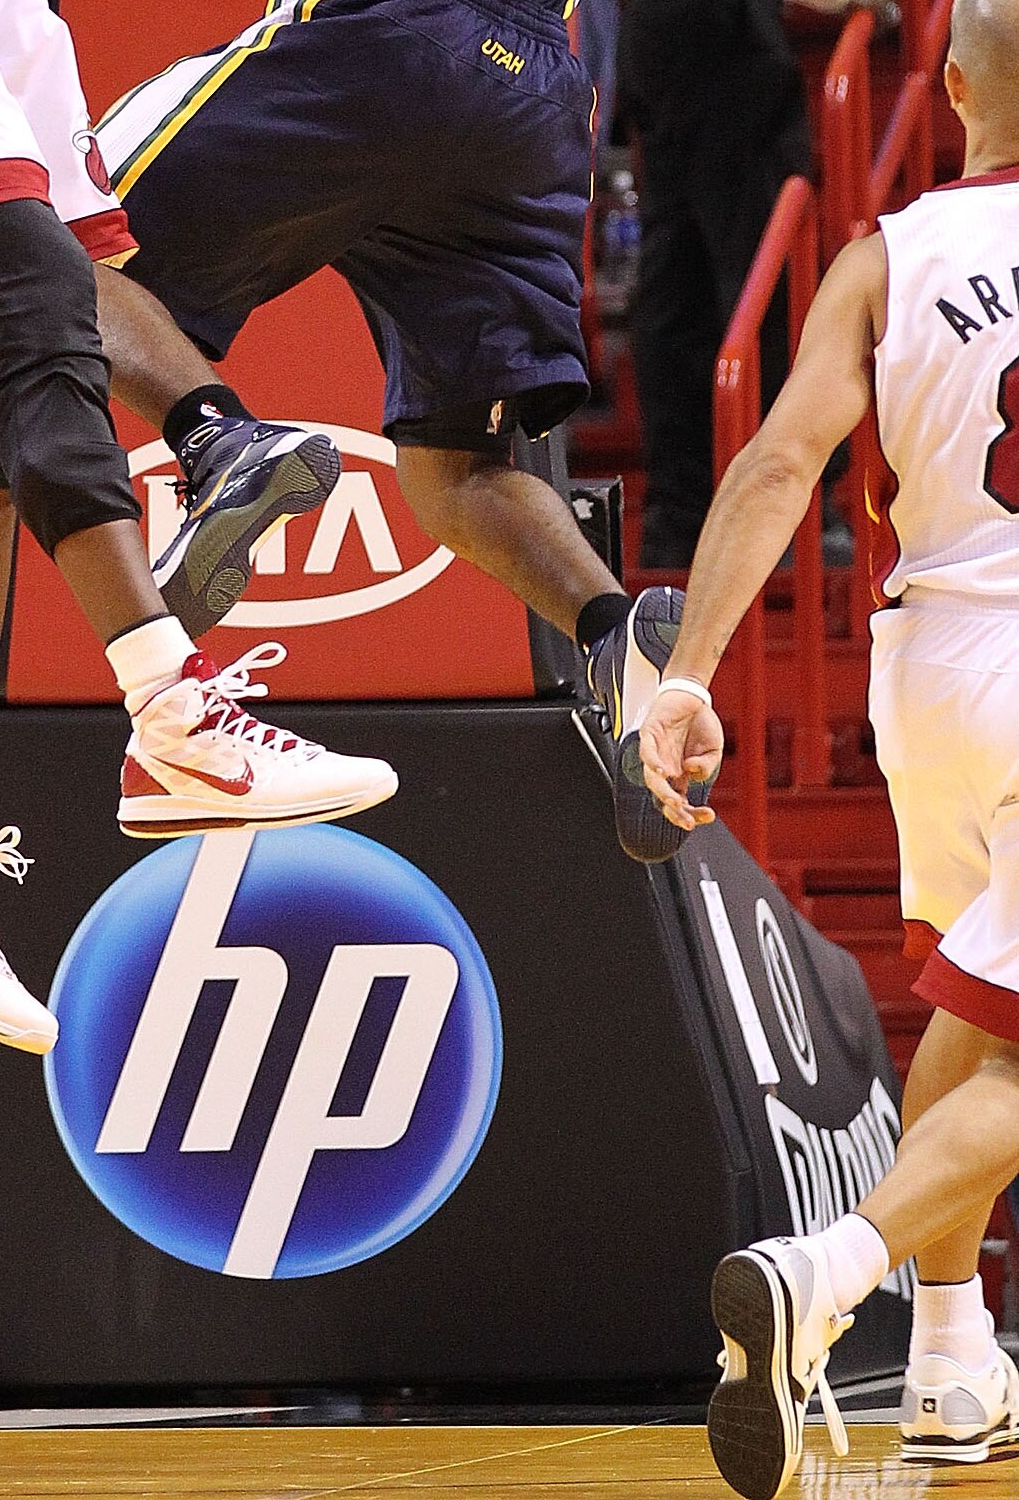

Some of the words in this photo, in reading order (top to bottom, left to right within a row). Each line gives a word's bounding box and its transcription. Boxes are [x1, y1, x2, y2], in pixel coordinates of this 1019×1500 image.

[481, 38, 526, 75] UTAH
[935, 266, 1019, 344] AR
[94, 830, 460, 1280] hp
